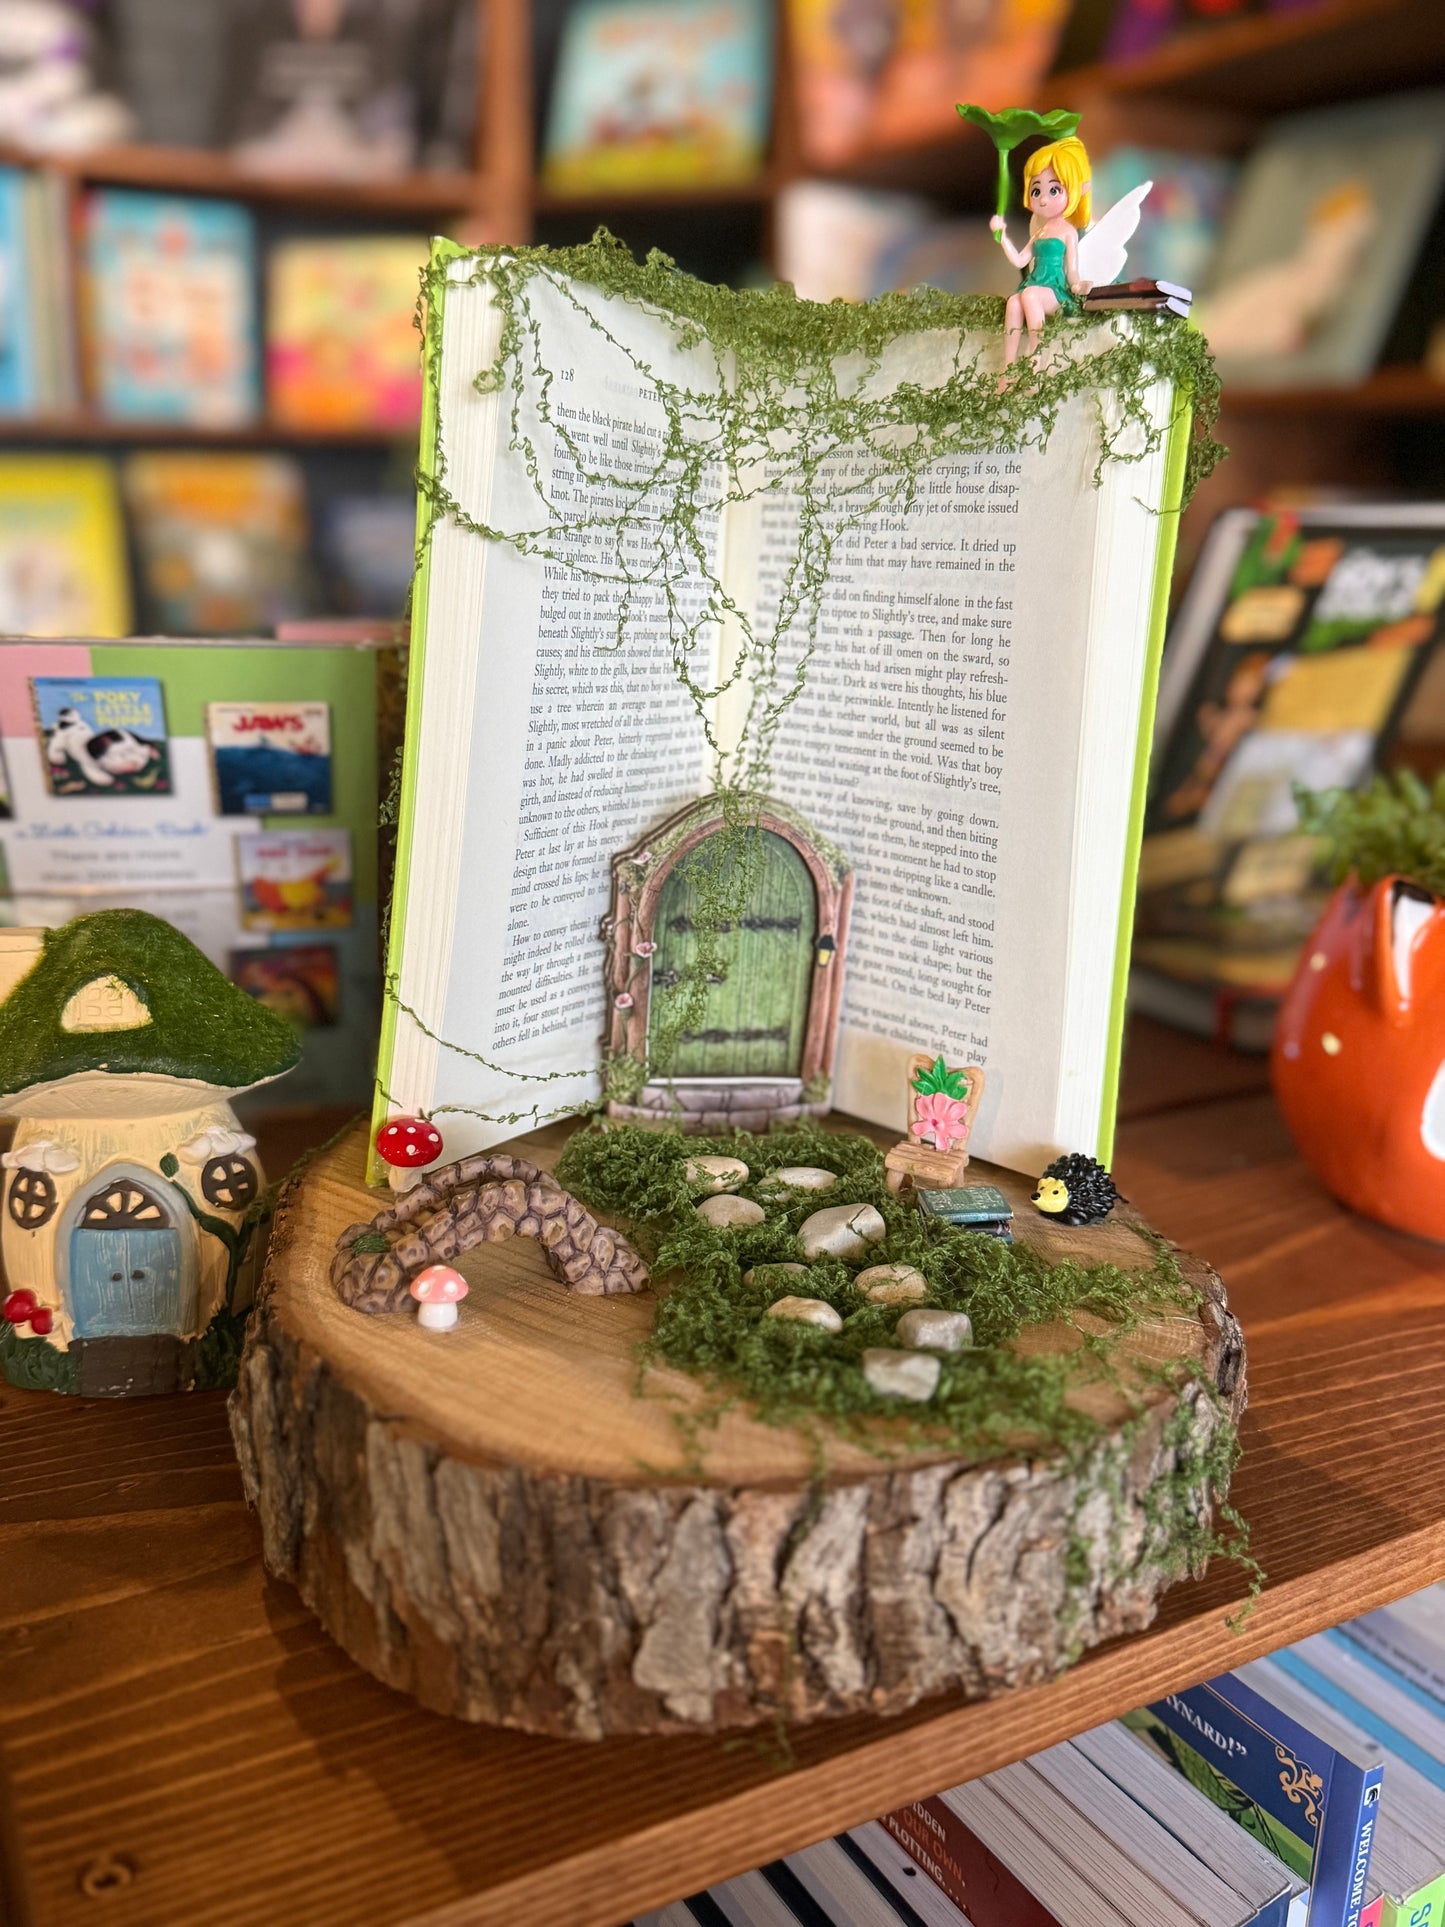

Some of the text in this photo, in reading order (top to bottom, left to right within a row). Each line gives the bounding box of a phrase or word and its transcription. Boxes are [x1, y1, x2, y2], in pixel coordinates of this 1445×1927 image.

[561, 368, 575, 382] 128
[556, 404, 646, 435] them the black pirate had
[570, 430, 660, 460] went well until Slightly's
[588, 451, 612, 467] be like
[551, 467, 584, 485] string in
[936, 460, 1021, 479] crying; if so, the
[550, 485, 614, 508] knot. The pirates
[929, 480, 1019, 497] little house disap-
[926, 499, 1018, 516] jet of smoke issued
[564, 529, 591, 547] strange
[900, 536, 1016, 556] bad service. It dried up
[600, 551, 613, 565] His
[910, 555, 1015, 572] have remained the
[544, 566, 582, 582] While his
[541, 586, 610, 606] they tried pack
[933, 593, 1013, 610] alone the fast
[539, 606, 581, 623] bulged out
[917, 612, 1011, 629] tree, and make sure
[538, 625, 604, 643] beneath Slightly's
[920, 628, 1011, 650] Then for long he
[536, 645, 590, 660] causes; and his
[943, 648, 1009, 667] the sward, so
[534, 664, 629, 680] Slightly, white gills,
[914, 665, 1007, 684] might play refresh-
[532, 682, 593, 696] his secret, which
[921, 683, 1007, 703] thoughts, his blue
[557, 699, 604, 713] tree wherein
[951, 703, 1006, 721] listened for
[232, 713, 304, 733] JAWS
[528, 716, 613, 736] Slightly, most wretched
[941, 724, 1004, 740] was silent
[546, 734, 614, 754] panic about Peter,
[939, 741, 1003, 758] seemed be
[524, 752, 604, 770] done. Madly addicted
[937, 754, 1002, 779] Was that boy
[522, 778, 536, 788] was
[933, 772, 1000, 795] Slightly's tree,
[520, 788, 583, 810] girth, and instead
[518, 811, 552, 824] unknown
[936, 809, 998, 828] going down.
[523, 826, 558, 841] Sufficient
[946, 826, 998, 849] then biting
[515, 843, 561, 860] Peter last
[981, 849, 997, 863] the
[512, 861, 553, 880] design that
[943, 858, 996, 883] had stop
[511, 875, 559, 896] mind crossed
[961, 883, 995, 897] candle.
[509, 902, 527, 913] were
[968, 918, 994, 931] stood
[512, 934, 530, 946] How
[972, 932, 993, 948] him.
[503, 942, 551, 967] might indeed
[958, 949, 993, 964] various
[501, 967, 530, 982] the way
[976, 968, 992, 981] the
[498, 980, 531, 999] mounted
[977, 984, 991, 998] for
[496, 1004, 515, 1017] must
[964, 997, 990, 1014] Peter
[494, 1022, 510, 1034] into
[492, 1028, 530, 1050] others fell
[966, 1049, 987, 1066] play
[903, 1809, 930, 1846] OUR
[1350, 1819, 1374, 1910] WELCOME
